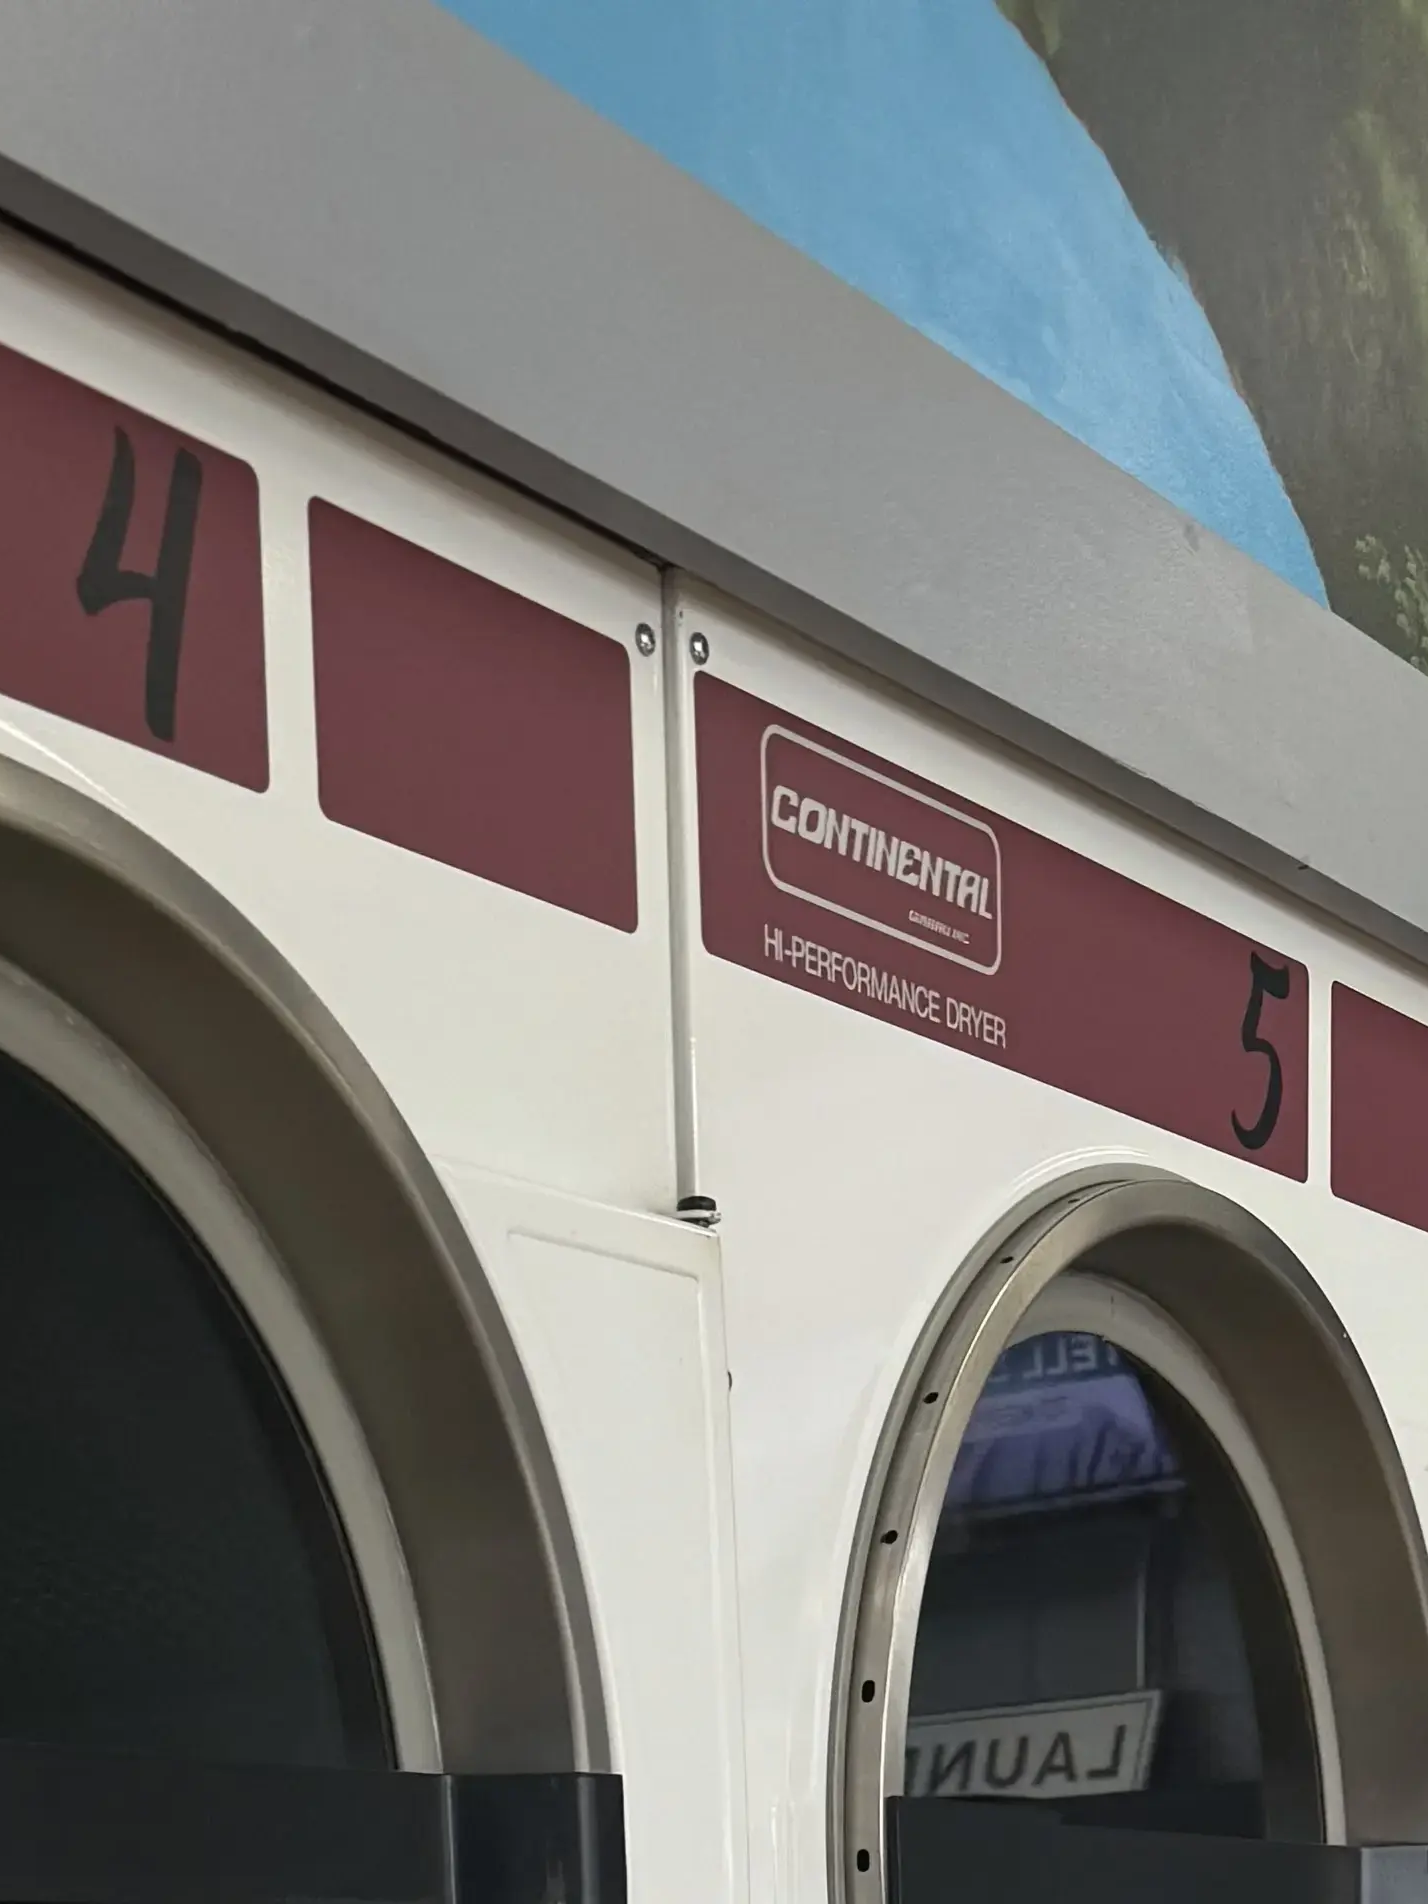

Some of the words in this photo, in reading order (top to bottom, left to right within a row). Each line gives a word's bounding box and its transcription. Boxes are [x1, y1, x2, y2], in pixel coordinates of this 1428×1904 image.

[77, 424, 203, 742] 4
[770, 784, 994, 920] CONTINENTAL
[763, 923, 941, 1024] HI-PERFORMANCE
[946, 996, 1007, 1049] DRYER
[1230, 950, 1290, 1151] 5
